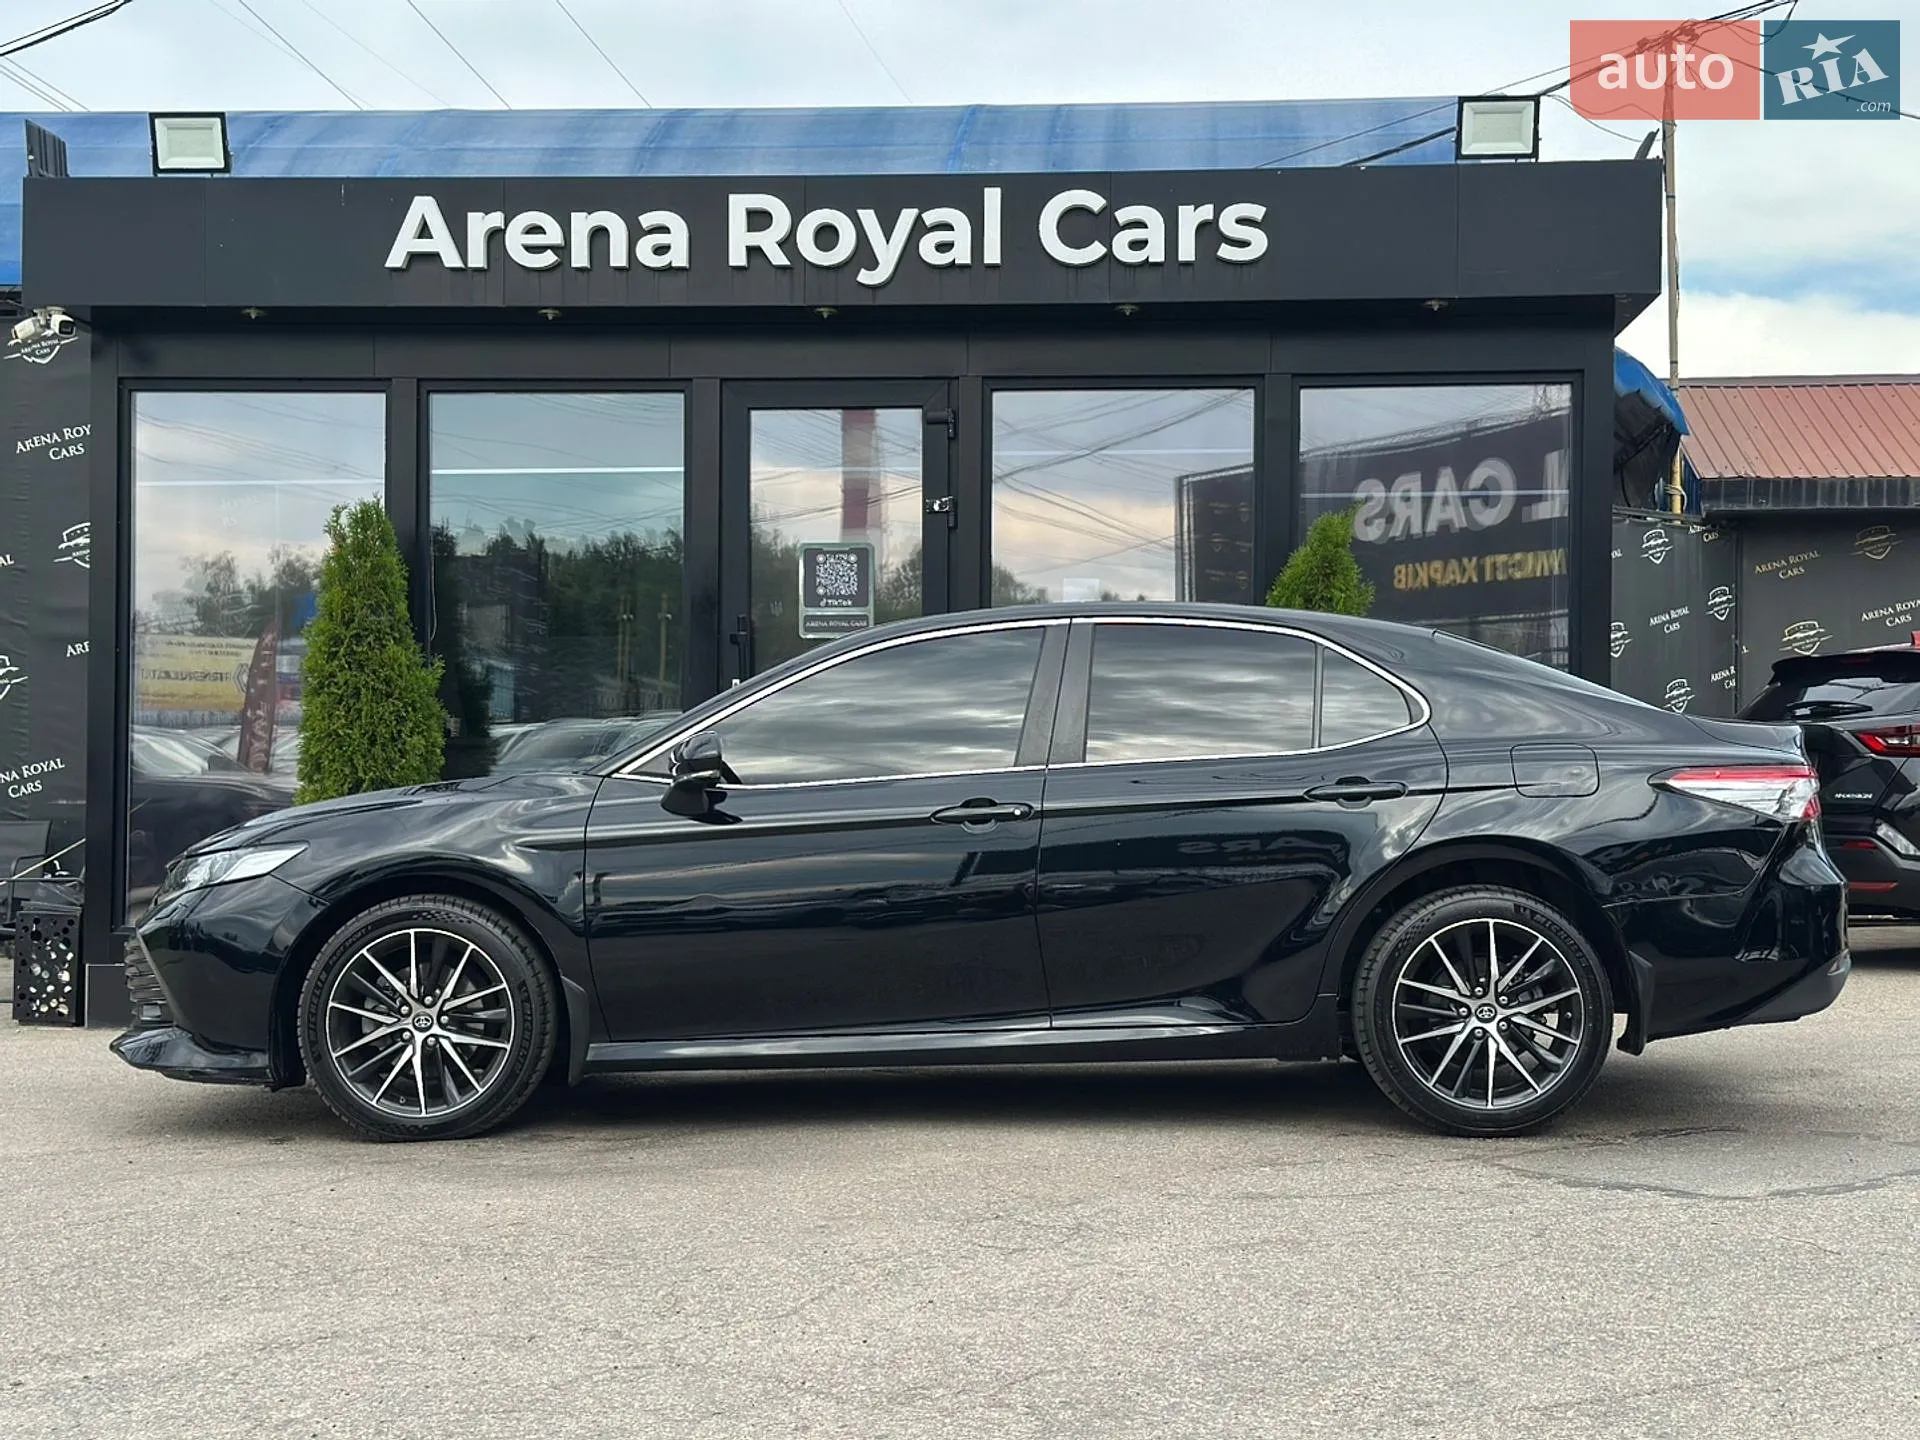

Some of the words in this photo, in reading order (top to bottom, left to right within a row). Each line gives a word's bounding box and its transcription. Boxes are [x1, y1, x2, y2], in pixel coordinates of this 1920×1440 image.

[385, 194, 690, 272] Arena
[727, 186, 1003, 288] Royal
[1038, 187, 1269, 267] Cars
[16, 432, 61, 454] ARENA
[48, 442, 85, 461] CARS
[1754, 559, 1787, 575] ARENA
[1788, 549, 1820, 565] ROYAL
[1778, 565, 1804, 580] CARS
[1649, 612, 1670, 627] ARENA
[1670, 605, 1690, 619] ROYAL
[1861, 606, 1894, 622] ARENA
[1886, 613, 1912, 627] CARS
[1663, 621, 1680, 634] CARS
[21, 758, 65, 778] ROYAL
[7, 779, 43, 799] CARS
